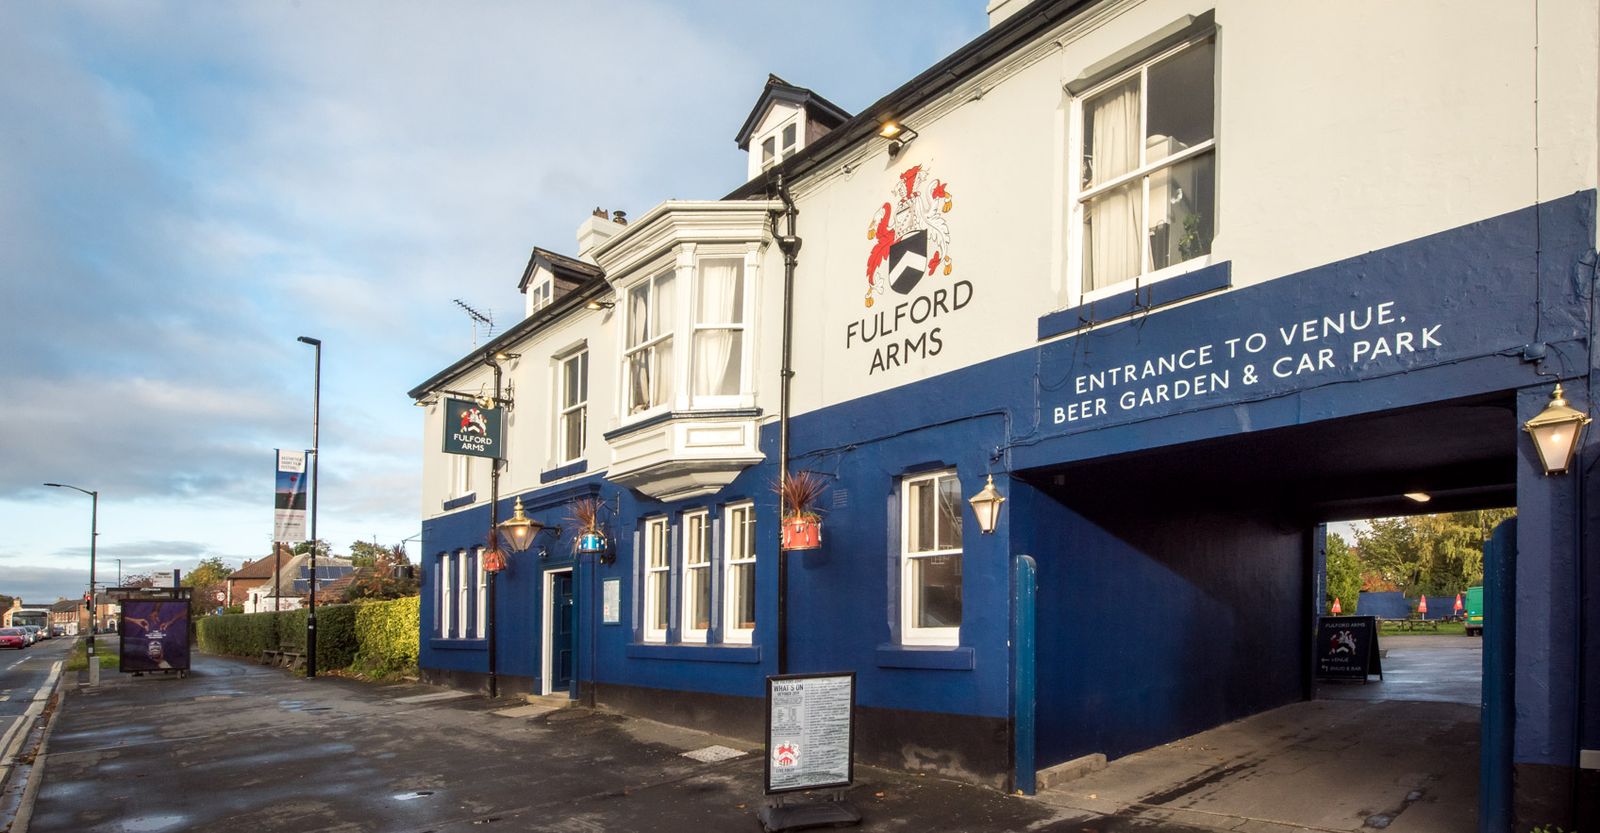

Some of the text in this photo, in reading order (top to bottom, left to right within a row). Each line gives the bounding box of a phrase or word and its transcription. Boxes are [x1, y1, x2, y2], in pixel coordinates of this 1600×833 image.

[846, 279, 973, 349] FULFORD
[869, 327, 943, 376] ARMS
[1053, 324, 1443, 425] BEER GARDEN & CAR PARK
[1075, 301, 1407, 395] ENTRANCE TO VENUE,
[453, 433, 493, 445] FULFORD
[461, 442, 485, 452] ARMS
